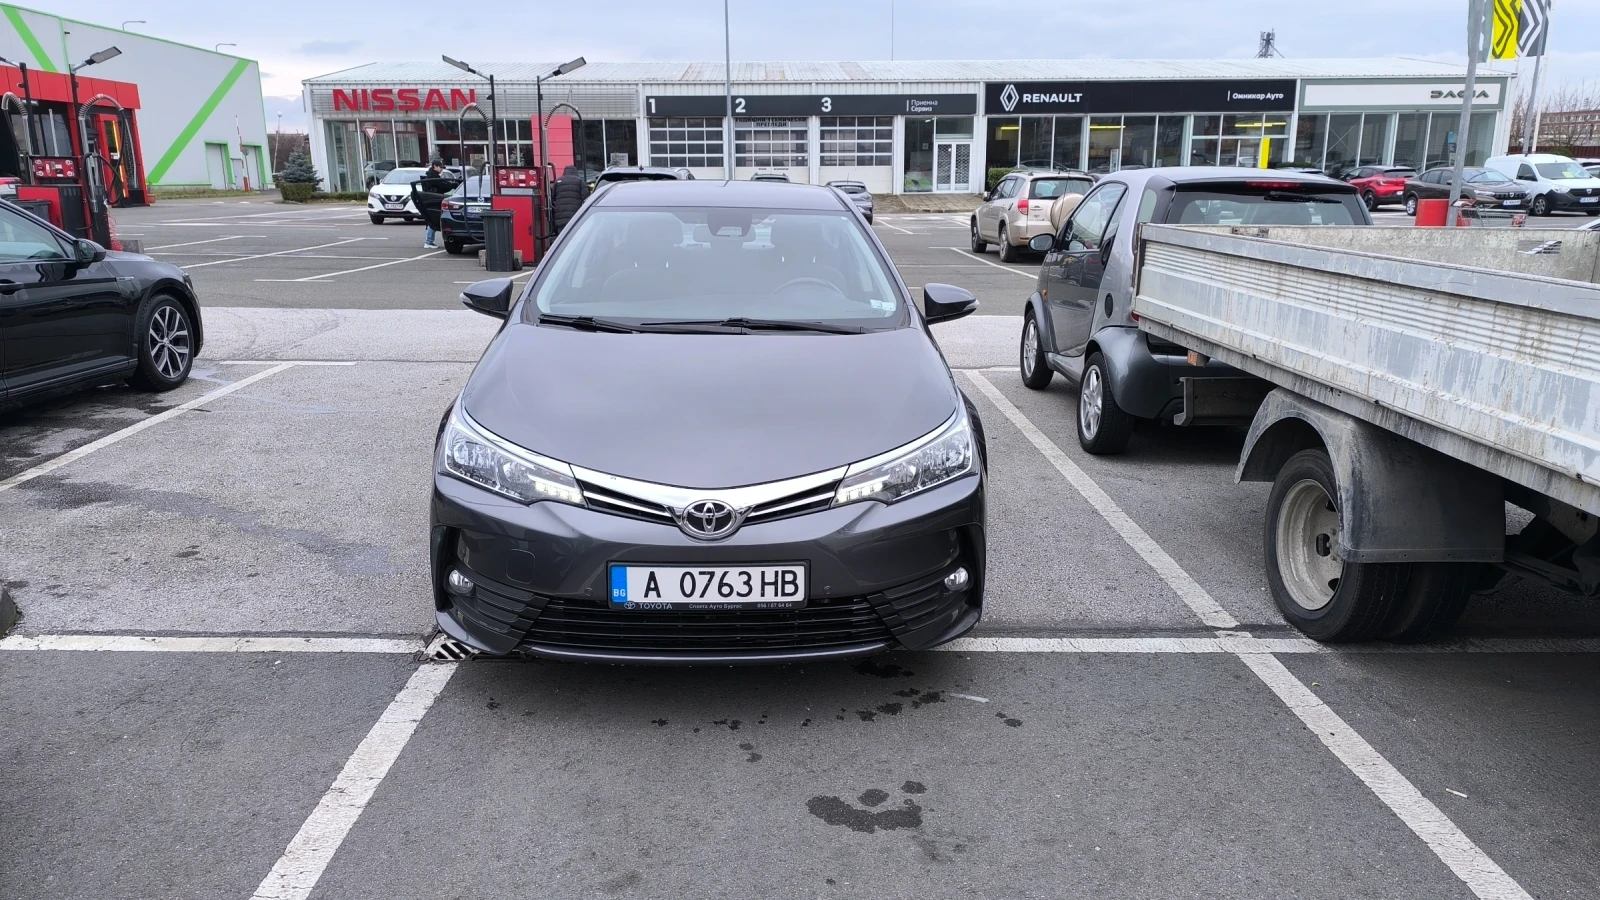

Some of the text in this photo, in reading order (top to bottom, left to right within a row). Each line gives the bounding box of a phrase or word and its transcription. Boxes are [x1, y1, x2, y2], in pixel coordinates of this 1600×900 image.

[332, 88, 476, 111] NISSAN
[1022, 93, 1083, 103] RENAULT
[1232, 92, 1284, 101] Омникар Ауто
[648, 98, 656, 114] 1
[735, 98, 746, 113] 2
[821, 97, 832, 113] 3
[643, 569, 799, 598] A 0763 HB
[613, 588, 626, 597] BG
[638, 602, 673, 610] TOYOTA
